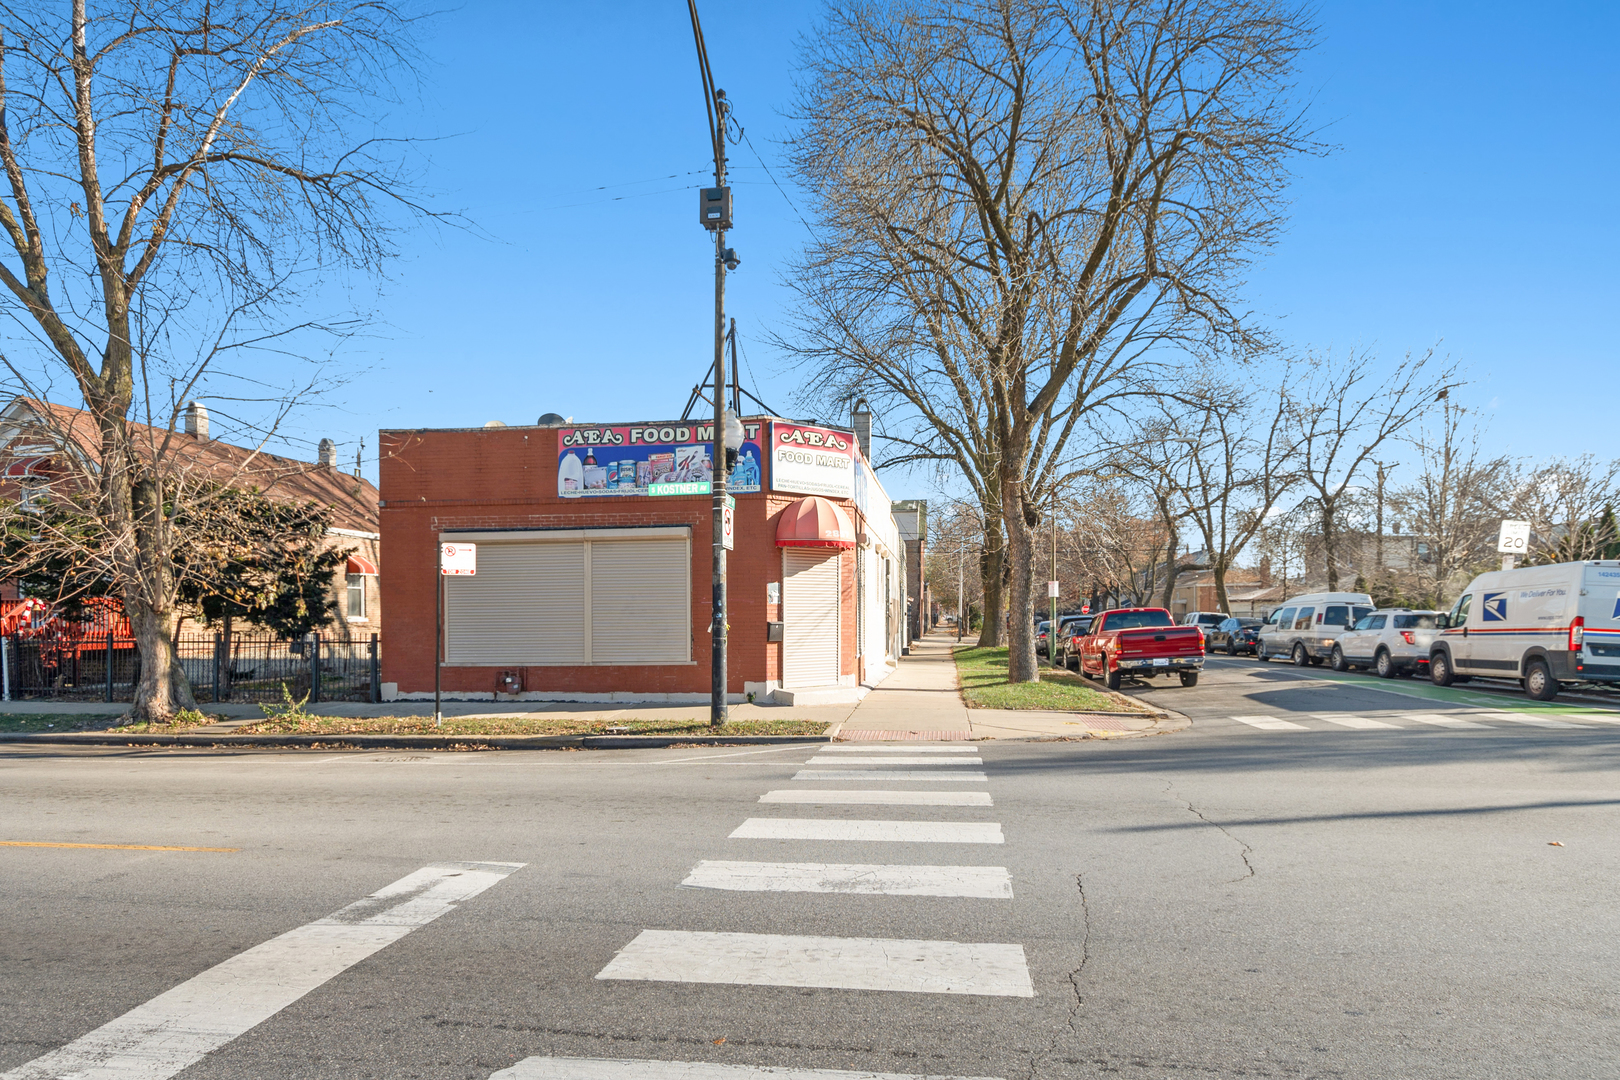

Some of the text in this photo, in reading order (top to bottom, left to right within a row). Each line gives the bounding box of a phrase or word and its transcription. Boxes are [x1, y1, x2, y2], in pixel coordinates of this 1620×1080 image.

[630, 426, 691, 444] FOOD
[696, 424, 760, 442] MT
[778, 450, 850, 469] FOOD MART
[657, 483, 698, 494] KOSTNER
[1504, 537, 1524, 548] 20
